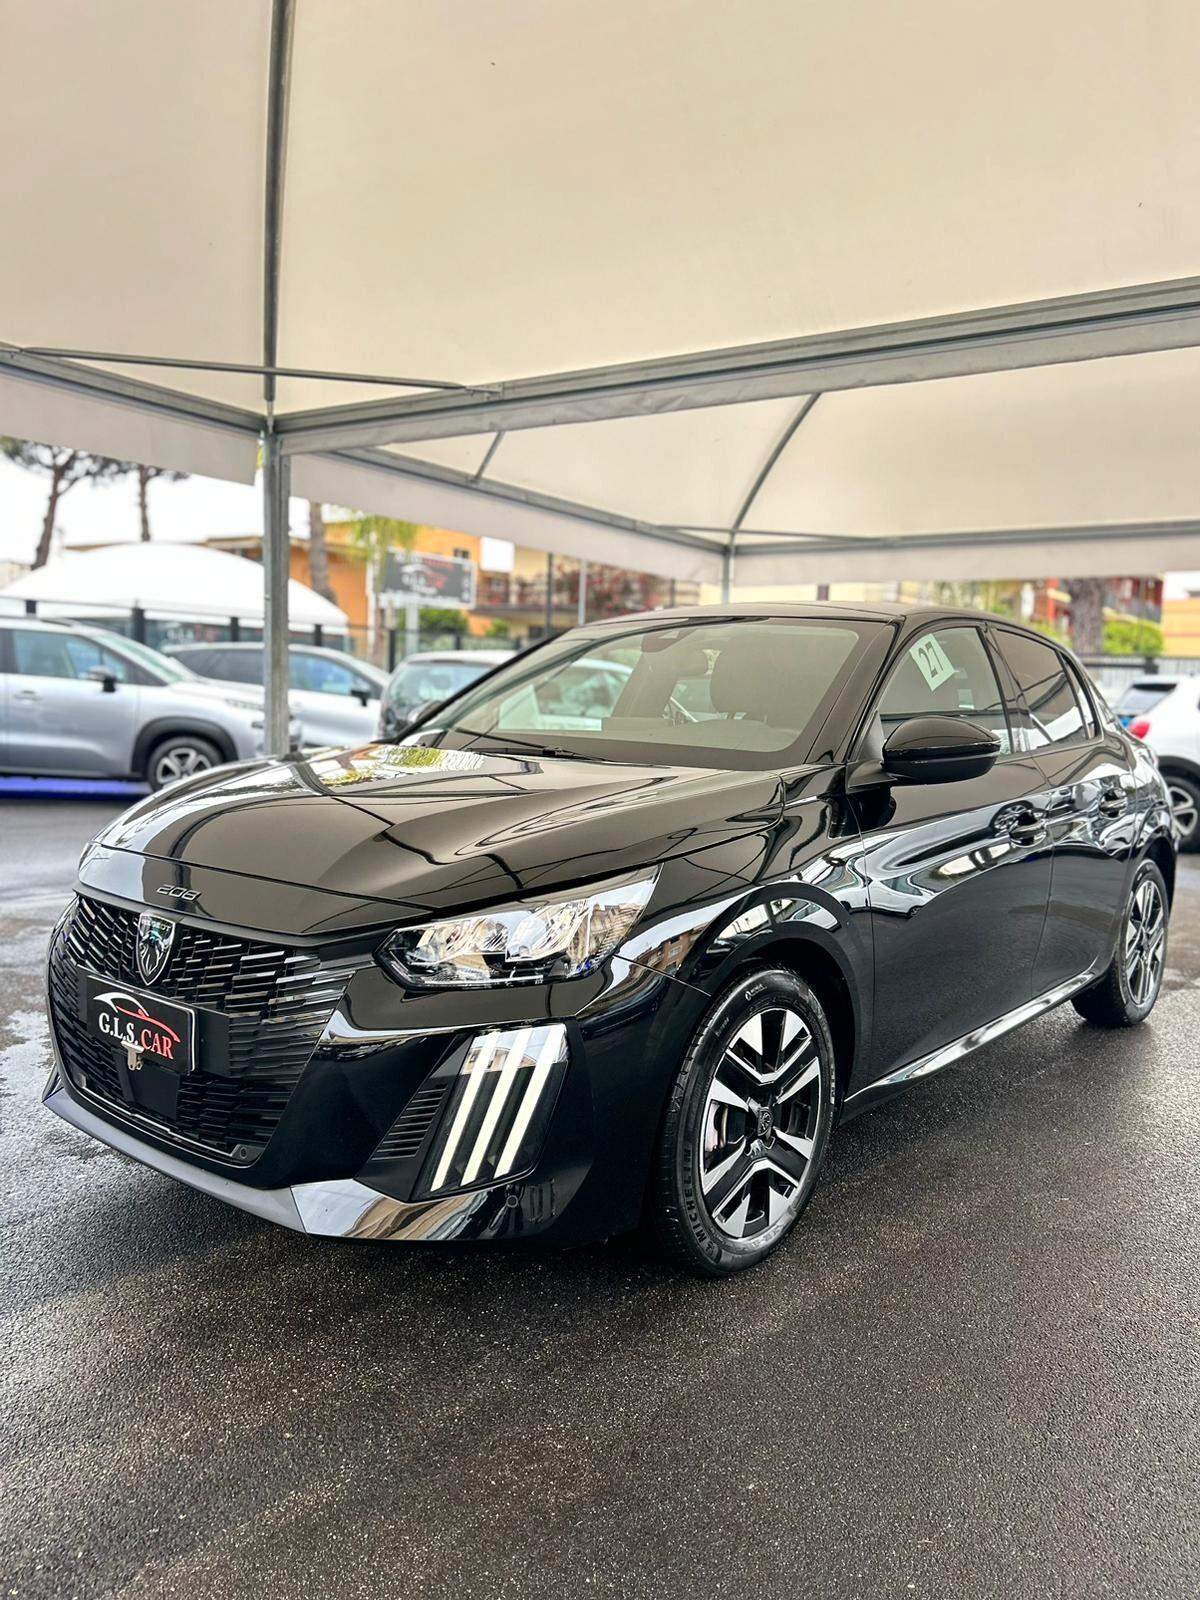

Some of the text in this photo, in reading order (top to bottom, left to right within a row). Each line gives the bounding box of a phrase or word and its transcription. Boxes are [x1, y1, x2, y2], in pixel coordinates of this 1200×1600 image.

[918, 641, 944, 678] 27
[156, 884, 201, 901] 208
[98, 1012, 174, 1060] G.L.S. CAR
[683, 1148, 707, 1243] MICHELIN
